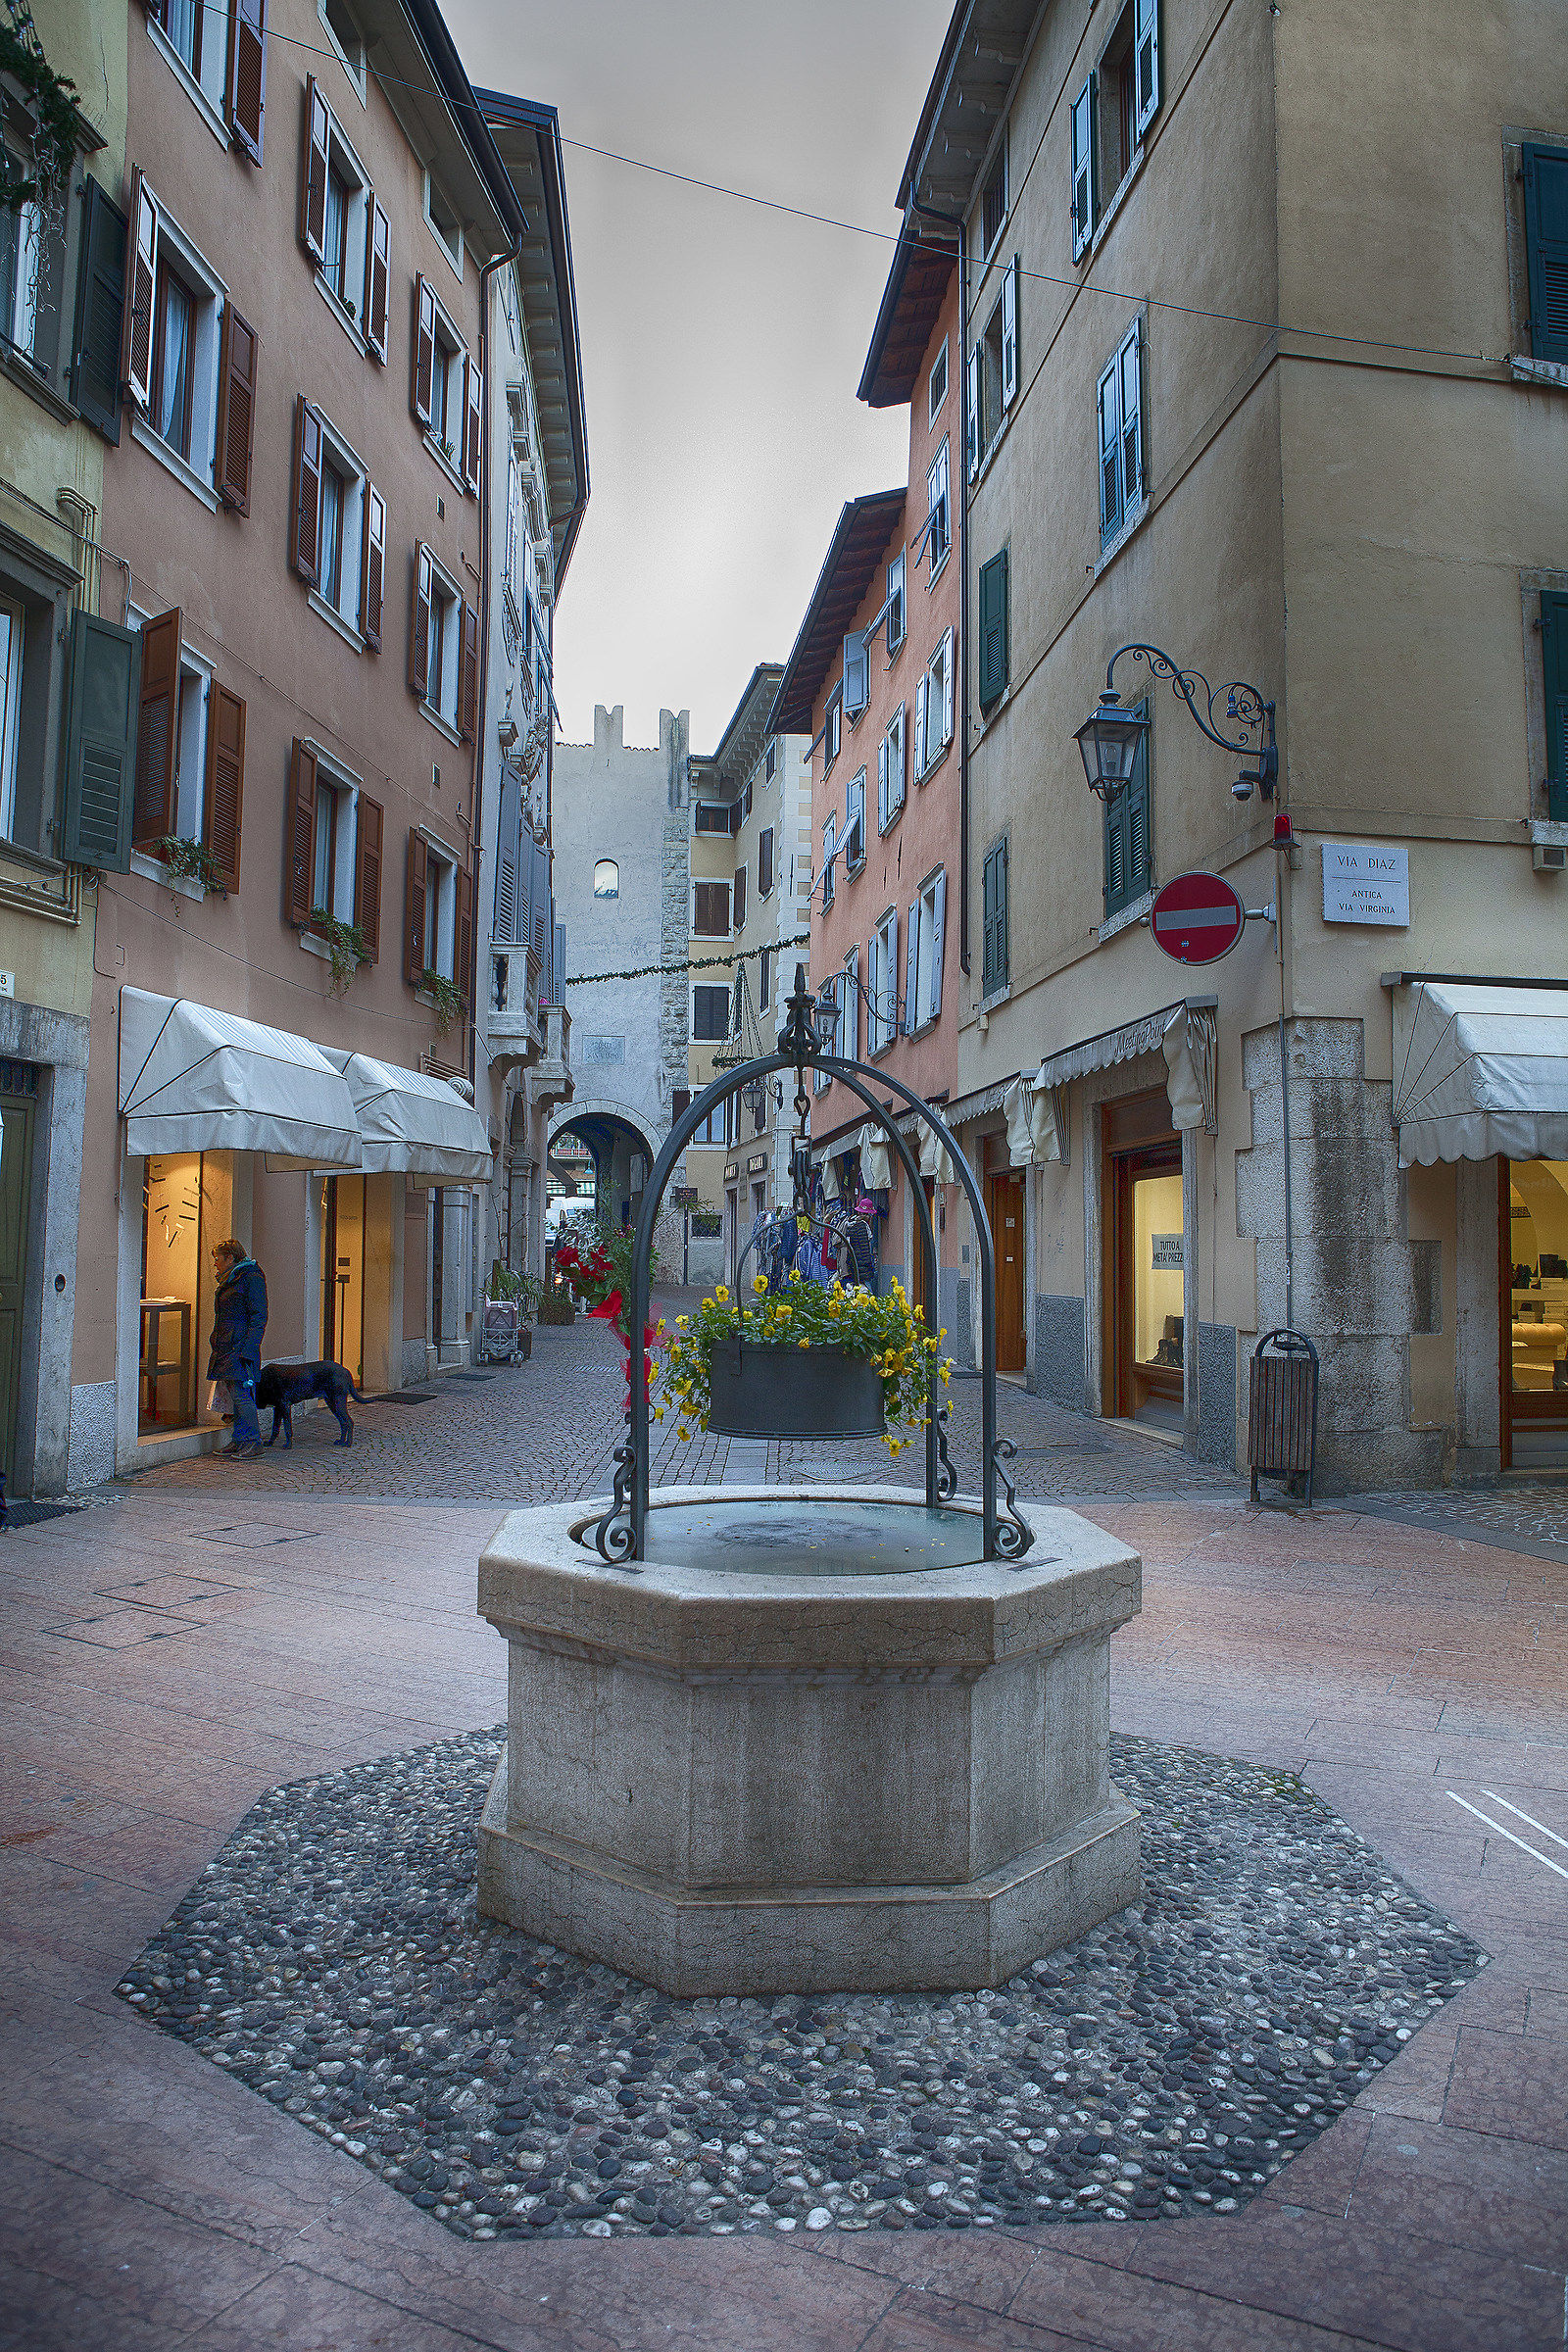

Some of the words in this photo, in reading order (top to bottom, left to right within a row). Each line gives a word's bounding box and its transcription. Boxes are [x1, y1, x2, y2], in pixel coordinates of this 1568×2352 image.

[1337, 856, 1358, 867] VIA
[1368, 858, 1396, 870] DIAZ
[1351, 890, 1383, 900] ANTICA
[1338, 903, 1354, 911] VIA
[1359, 905, 1396, 914] VIRGINIA
[1160, 1241, 1176, 1250] TUTTO
[1176, 1241, 1181, 1250] A
[1167, 1251, 1184, 1262] PREZZ
